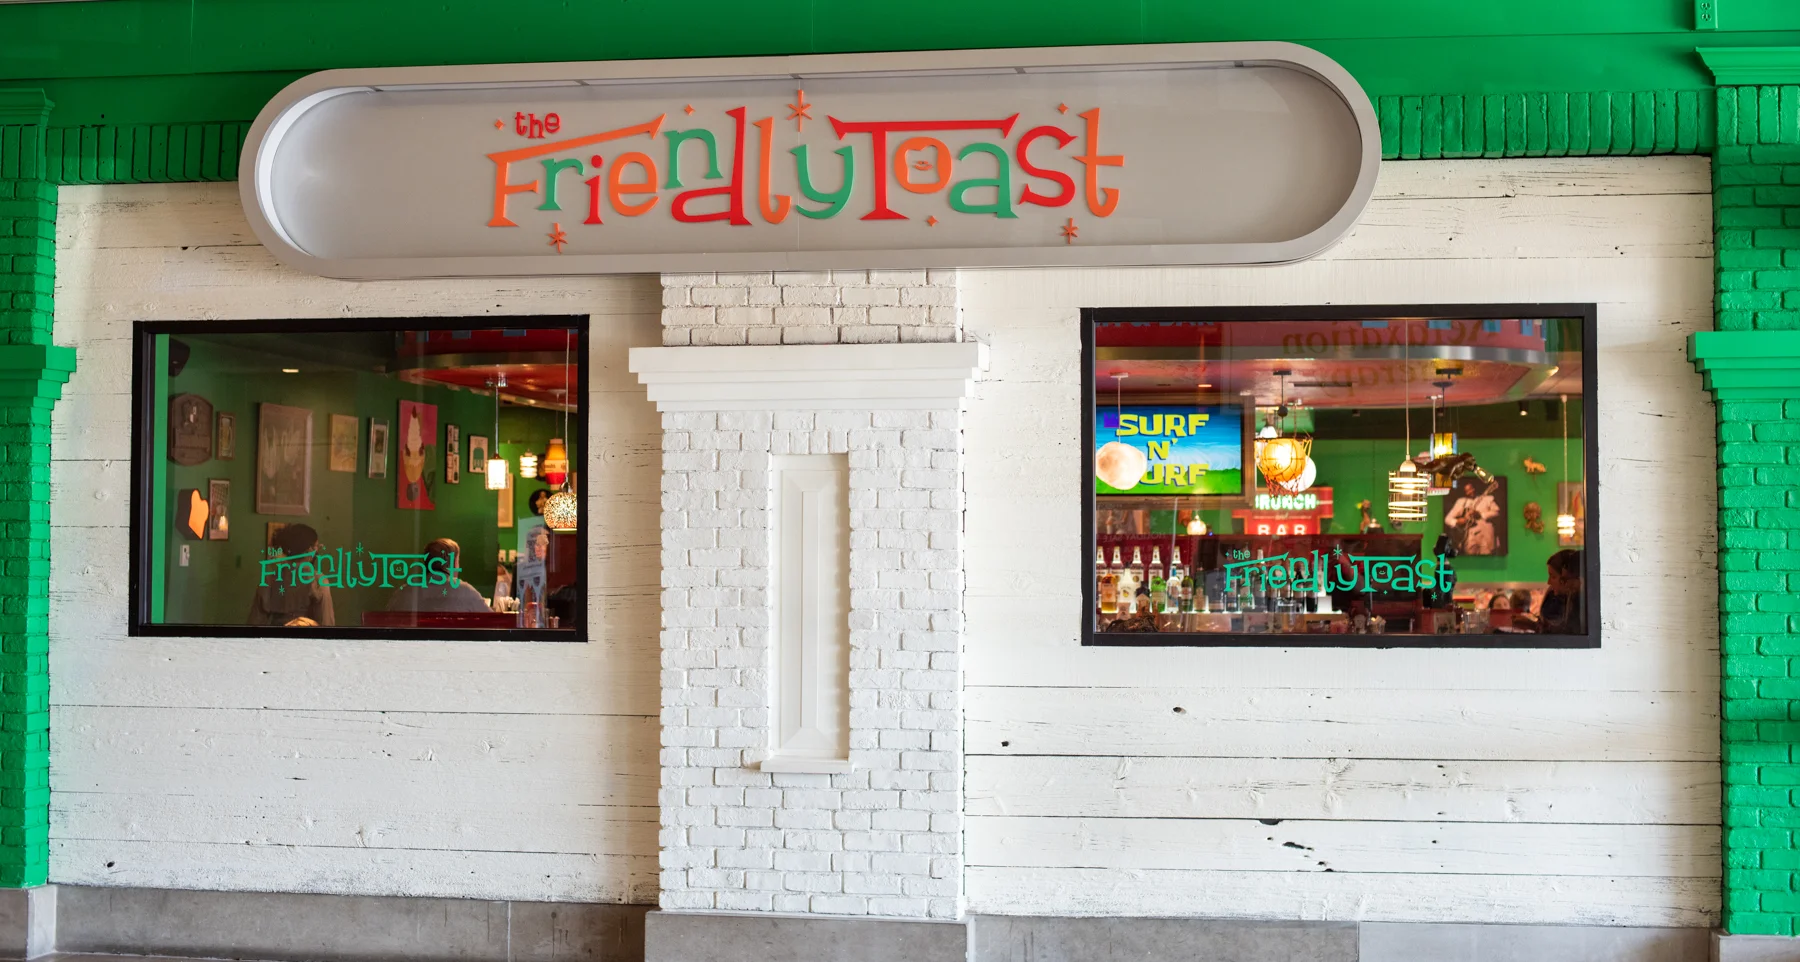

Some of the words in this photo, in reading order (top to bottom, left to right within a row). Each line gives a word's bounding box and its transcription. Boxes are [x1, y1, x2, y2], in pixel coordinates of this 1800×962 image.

[514, 111, 560, 139] the
[1116, 413, 1209, 436] SURF
[1147, 438, 1178, 459] N'
[1139, 463, 1209, 485] URF
[1257, 524, 1307, 535] BAR
[267, 546, 283, 556] the
[1232, 549, 1250, 560] the
